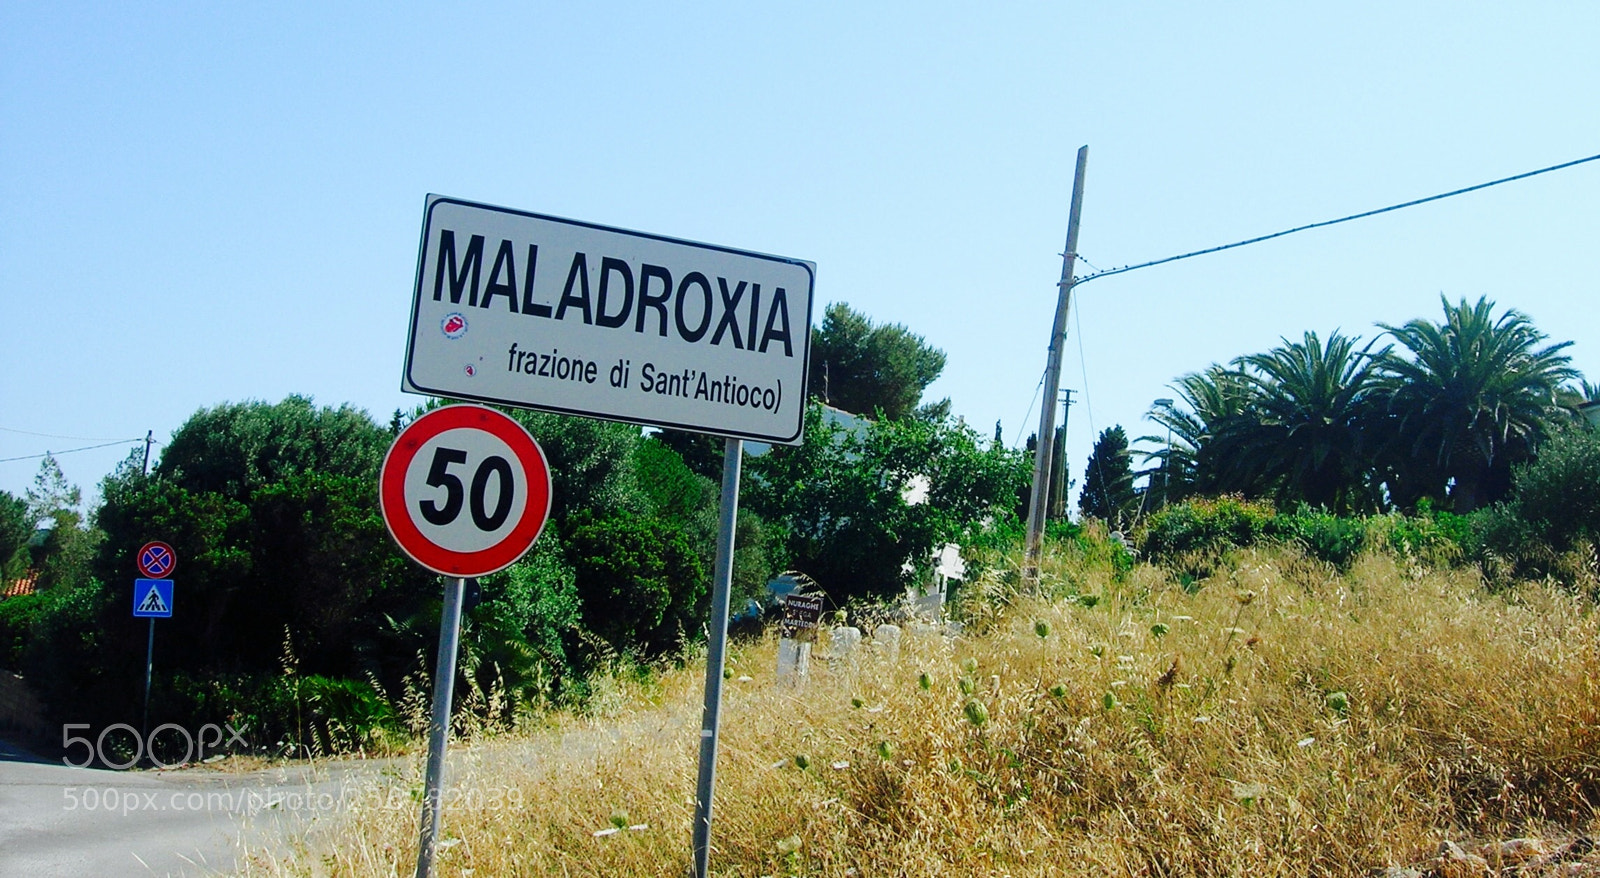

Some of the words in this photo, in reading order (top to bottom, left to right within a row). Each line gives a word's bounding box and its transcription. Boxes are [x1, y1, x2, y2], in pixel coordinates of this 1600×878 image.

[432, 228, 794, 358] MALADROXIA
[508, 343, 598, 384] frazione
[609, 359, 630, 389] di
[640, 362, 782, 415] Sant'Antioco)
[419, 447, 515, 532] 50
[787, 599, 819, 611] NURAGHE
